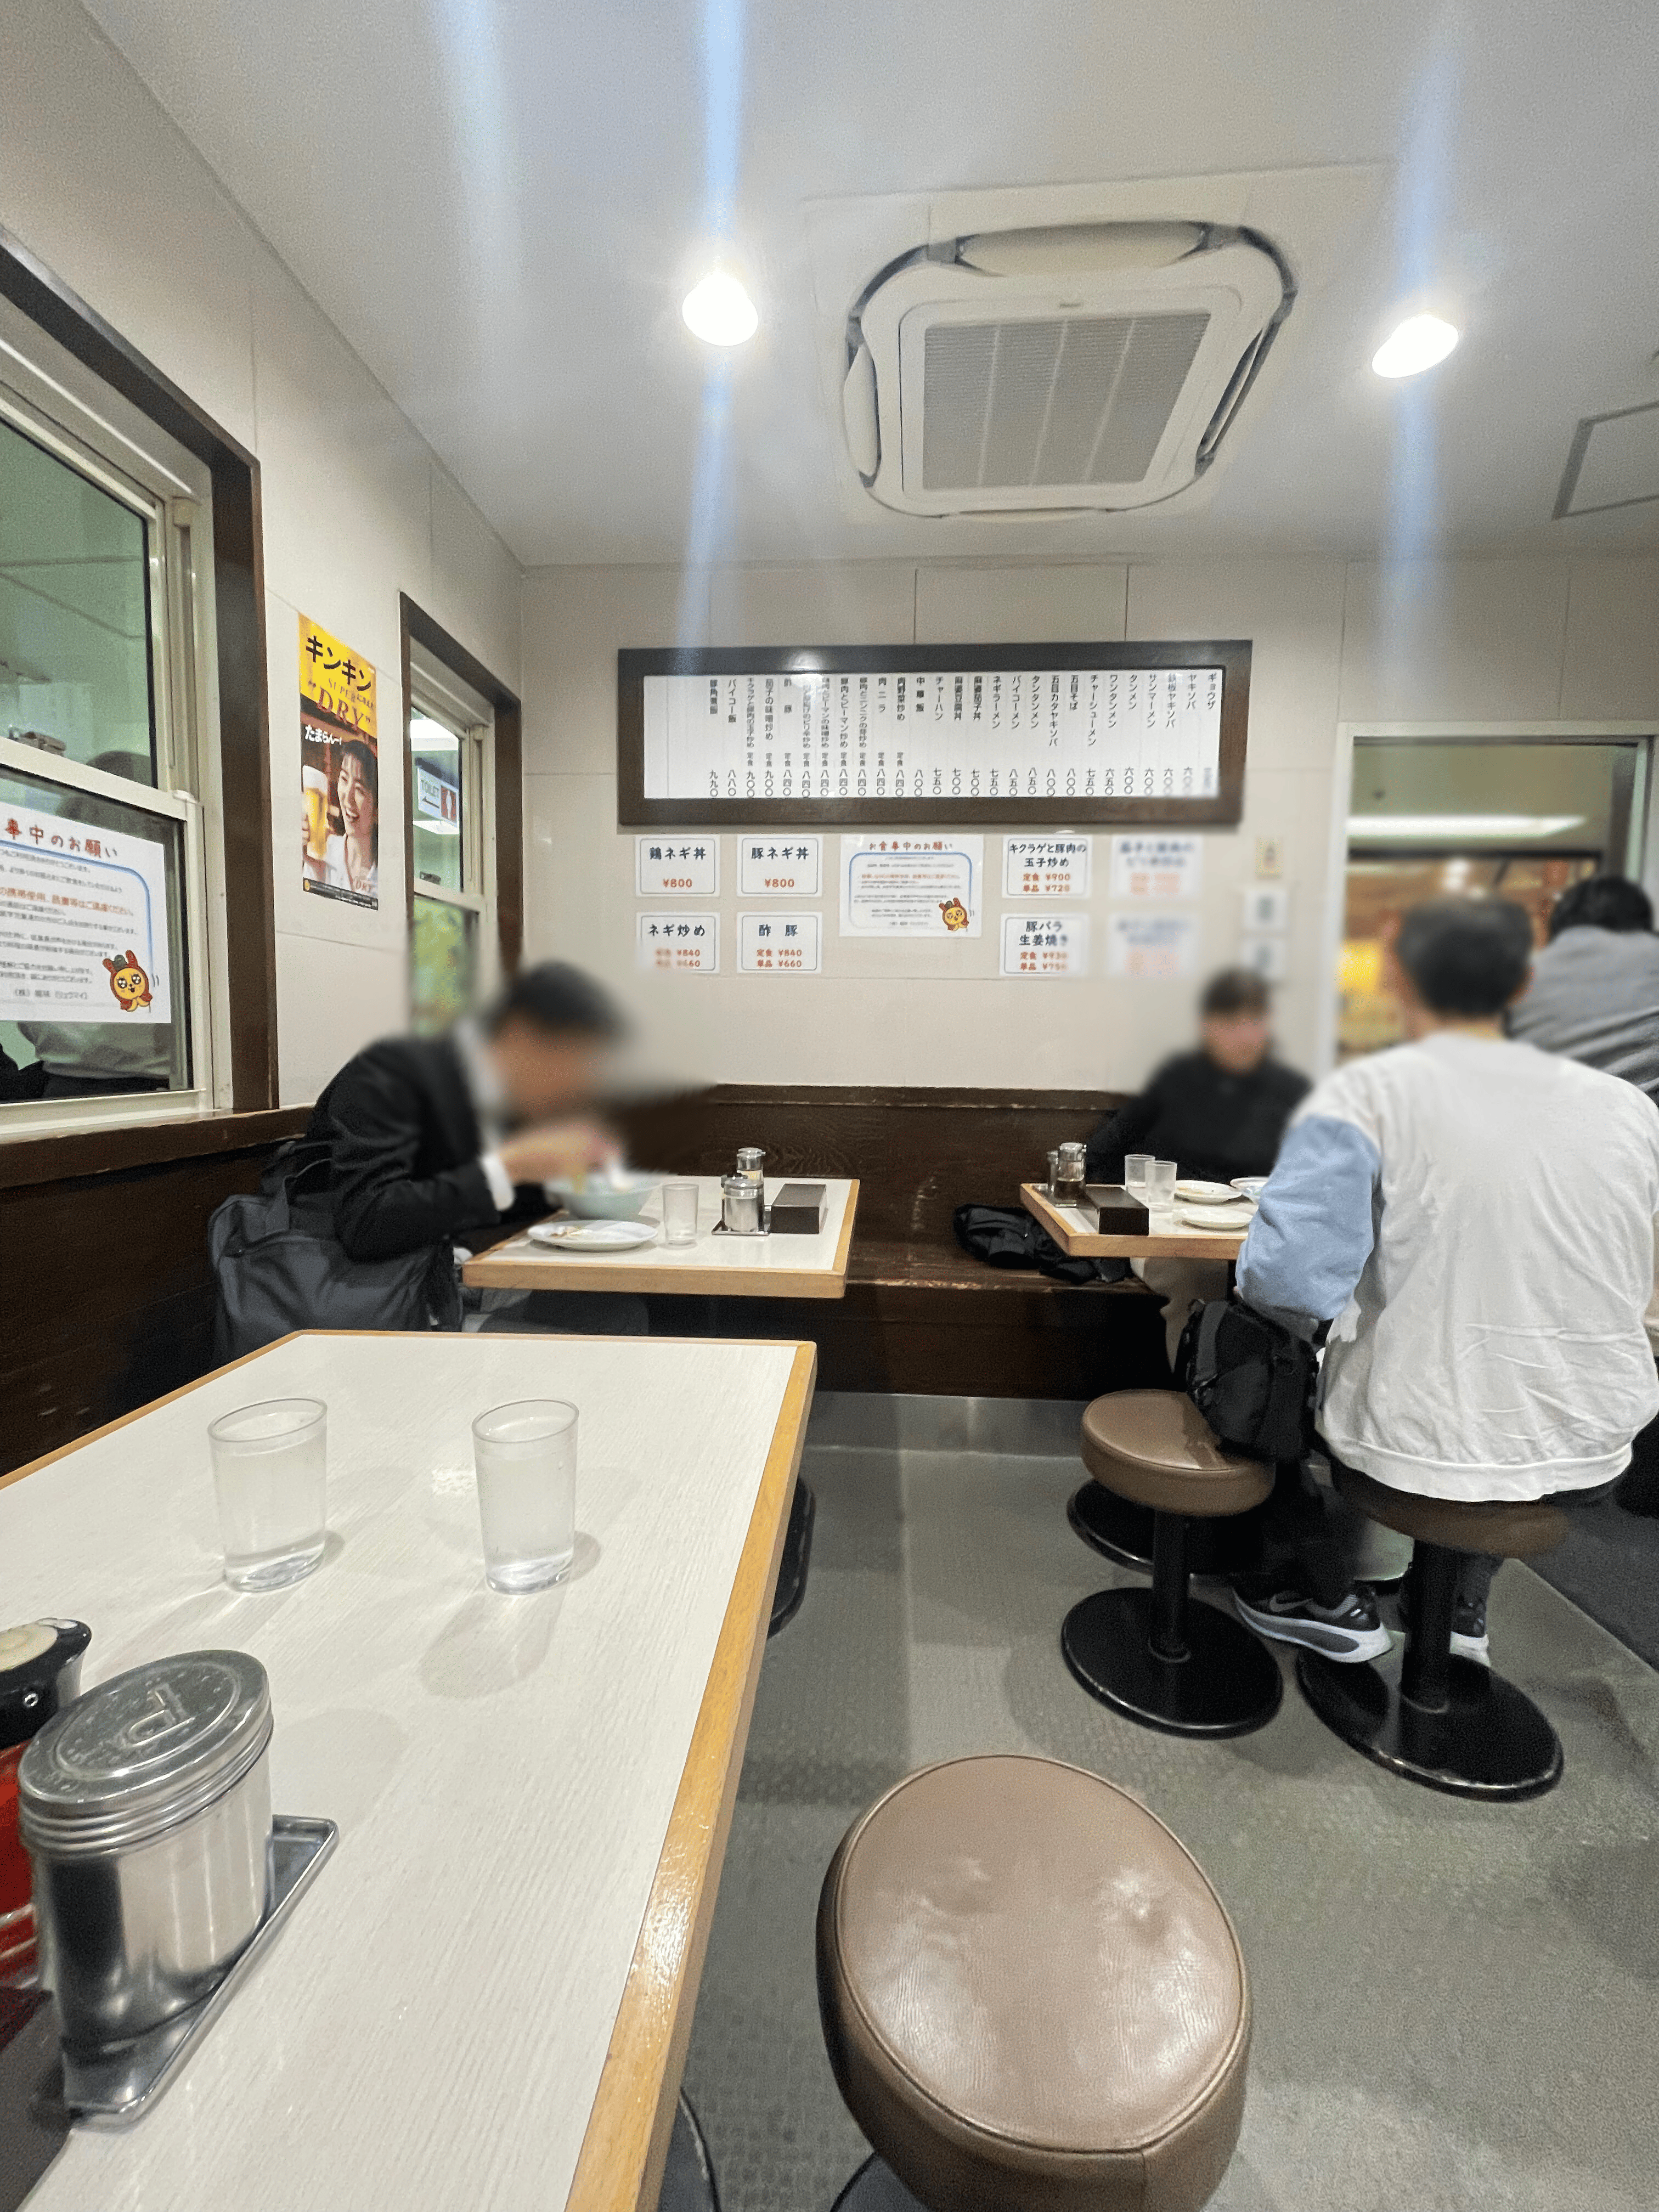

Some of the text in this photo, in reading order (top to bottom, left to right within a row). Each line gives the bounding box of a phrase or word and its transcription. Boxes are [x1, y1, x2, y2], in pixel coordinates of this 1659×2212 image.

[306, 636, 371, 691] キンキン
[328, 678, 356, 703] SUPER
[1147, 674, 1157, 729] サンマーメン
[1187, 674, 1197, 709] ヤキソバ
[933, 676, 944, 795] チャーハン 七五〇
[990, 675, 1001, 795] ネギラーメン 七五〇
[1028, 675, 1040, 795] タンタンメン 八五〇
[1066, 675, 1079, 795] 五目そば 八〇〇
[1085, 675, 1098, 795] チャーシューメン 七五〇
[1105, 674, 1118, 795] ワンタンメン 六五〇
[1124, 674, 1137, 794] タンメン 六〇〇
[728, 769, 736, 796] 八八〇
[747, 771, 755, 797] 九〇〇
[765, 770, 774, 797] 九〇〇
[783, 769, 792, 796] 八四〇
[802, 771, 810, 797] 八四〇
[821, 770, 829, 796] 八四〇
[839, 769, 848, 795] 八四〇
[858, 769, 866, 796] 八四〇
[877, 769, 885, 795] 八四〇
[895, 770, 904, 797] 八四〇
[914, 769, 923, 797] 八〇〇
[952, 768, 961, 795] 七〇〇
[970, 769, 980, 795] 七〇〇
[1009, 769, 1018, 795] 八五〇
[1046, 769, 1056, 796] 八〇〇
[649, 847, 706, 860] 鶏ネギ丼
[751, 847, 809, 860] 豚ネギ丼
[869, 840, 952, 851] お食事中のお願い
[1009, 843, 1087, 854] キクラゲと豚肉の
[1024, 857, 1069, 867] 玉子炒め
[663, 878, 692, 888] ¥800
[764, 878, 794, 888] ¥800
[1045, 873, 1070, 882] ¥900
[649, 924, 706, 937] ネギ炒め
[1026, 921, 1062, 933] 豚バラ
